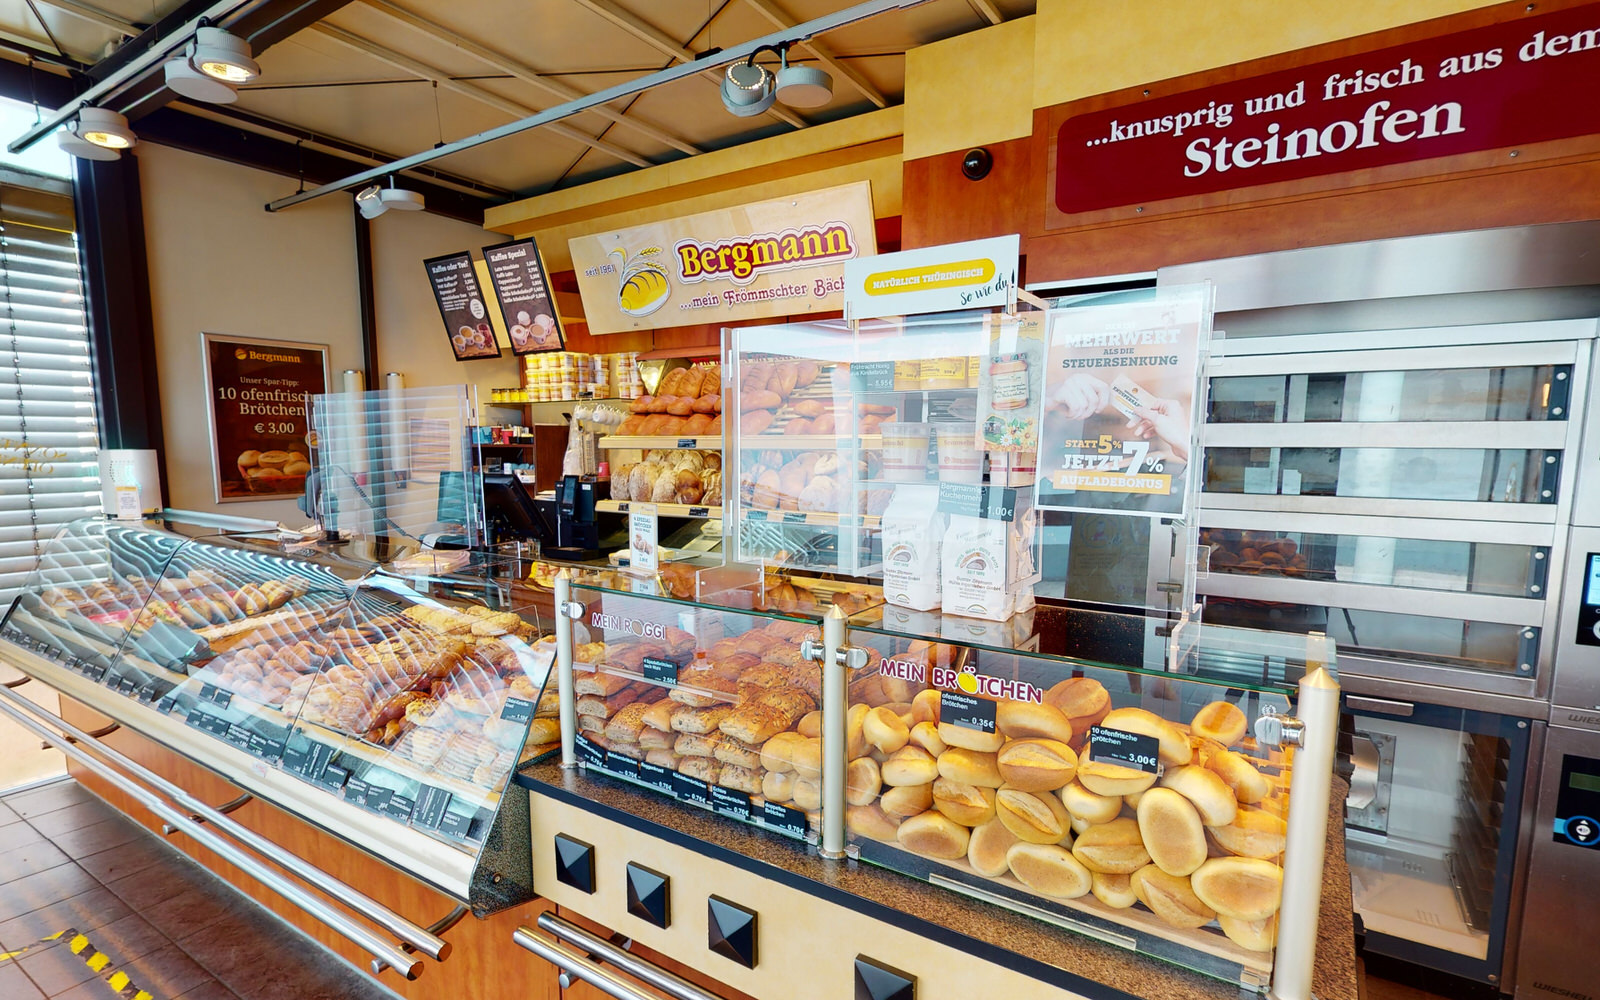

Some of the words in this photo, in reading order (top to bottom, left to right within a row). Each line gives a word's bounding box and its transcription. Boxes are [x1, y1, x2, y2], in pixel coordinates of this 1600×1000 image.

[1086, 102, 1233, 146] ...knusprig
[1244, 81, 1306, 115] und
[1323, 60, 1425, 101] frisch
[1438, 47, 1504, 79] aus
[1519, 28, 1600, 62] dem
[1183, 100, 1466, 178] Steinofen
[678, 226, 852, 279] Bergmann
[585, 265, 599, 277] seit
[872, 273, 921, 289] NATÜRLICH
[922, 268, 984, 284] THÜRINGISCH
[722, 282, 808, 308] Frömmschter
[960, 291, 973, 306] So
[974, 284, 993, 300] wie
[1064, 328, 1182, 349] MEHRWERT
[249, 350, 301, 364] Bergmann
[1103, 348, 1119, 356] ALS
[1119, 347, 1135, 355] DIE
[1062, 355, 1179, 369] STEUERSENKUNG
[239, 376, 262, 385] Unser
[263, 378, 300, 387] Spar-Tipp:
[218, 387, 237, 400] 10
[239, 402, 306, 417] Brötchen
[254, 423, 265, 434] €
[268, 422, 295, 434] 3,00
[1064, 439, 1098, 449] STATT
[1062, 454, 1125, 471] JETZT
[1059, 475, 1164, 489] AUFLADEBONUS
[591, 612, 621, 631] MEIN
[880, 658, 925, 683] MEIN
[932, 666, 1043, 704] BRÖTCHEN
[941, 692, 978, 706] ofenfrisches
[941, 699, 969, 711] Brötchen
[1091, 733, 1122, 746] Brötchen
[1100, 729, 1138, 742] ofenfrische
